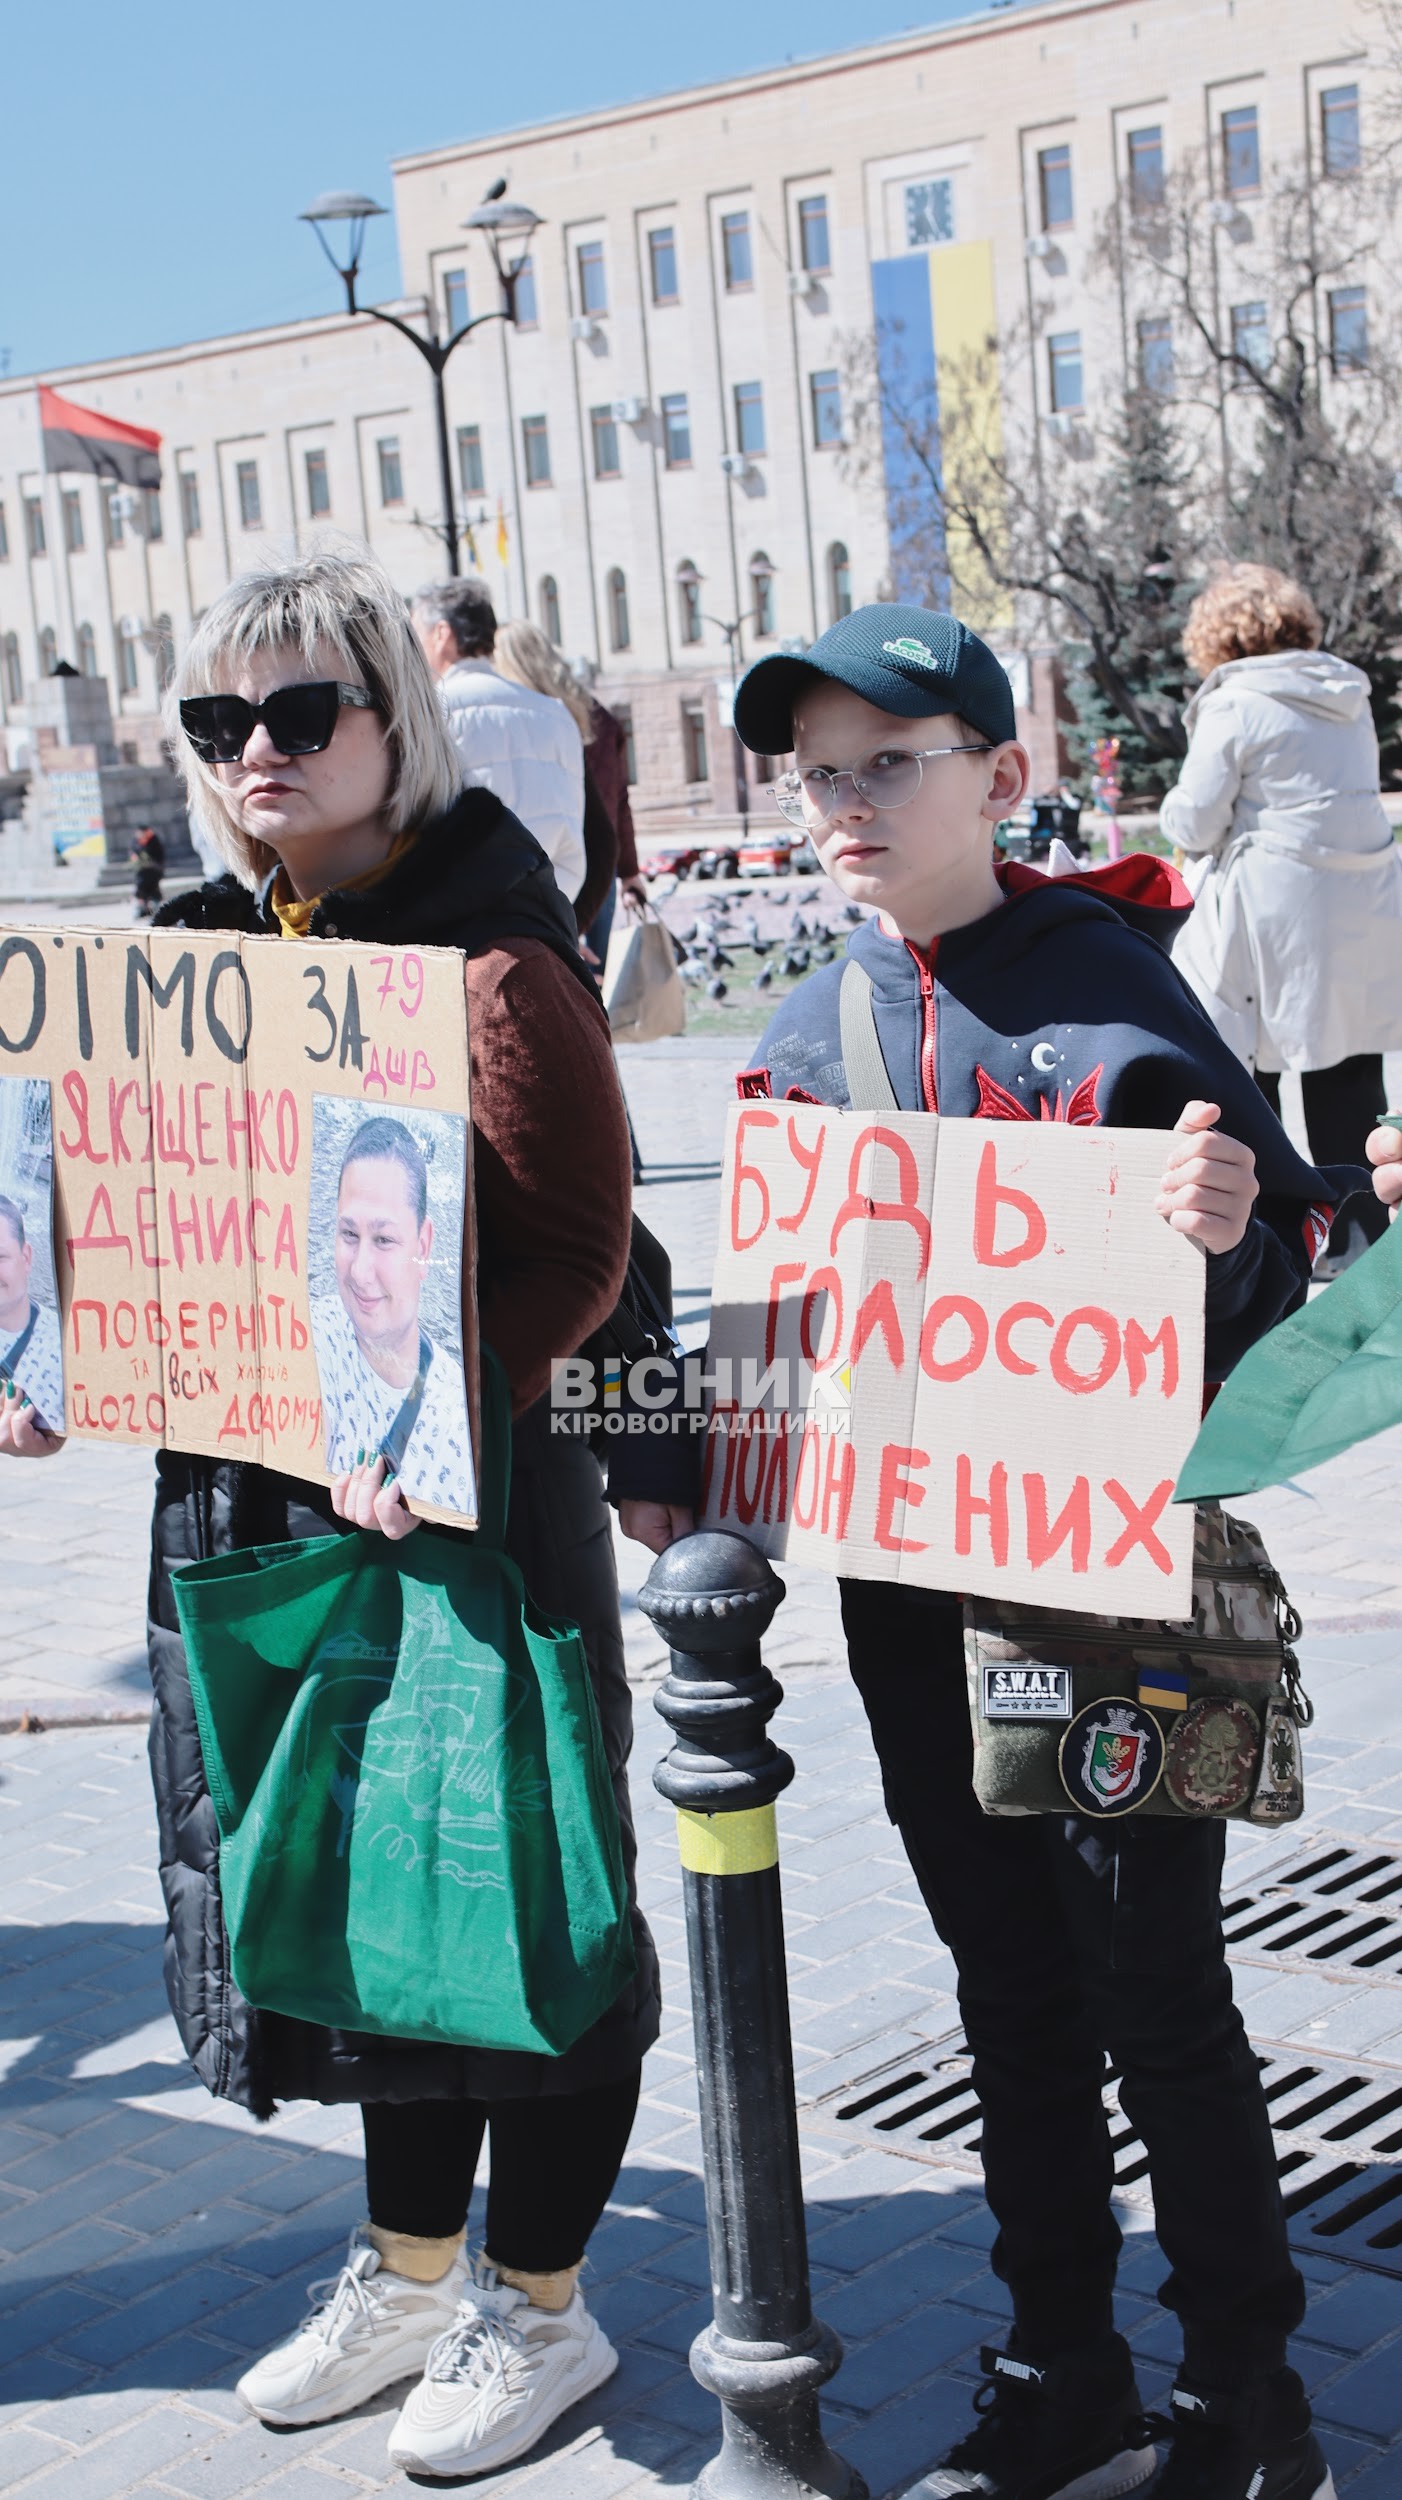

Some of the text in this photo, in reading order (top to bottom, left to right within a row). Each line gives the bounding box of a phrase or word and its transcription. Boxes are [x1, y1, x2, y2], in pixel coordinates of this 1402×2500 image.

[886, 643, 934, 667] LACOSTE
[303, 965, 370, 1071] ЗА
[370, 953, 425, 1018] 79
[363, 1049, 436, 1098] ДШВ
[59, 1069, 300, 1176] ЯКУЩЕНКО
[66, 1182, 299, 1277] ДЕНИСА
[731, 1109, 1047, 1282] БУДЬ
[72, 1287, 309, 1356] ПОВЕРНІТЬ
[765, 1261, 1179, 1399] ГОЛОСОМ
[701, 1398, 1176, 1575] ПОЛОНЕНИХ
[995, 1671, 1058, 1691] S.W.A.T
